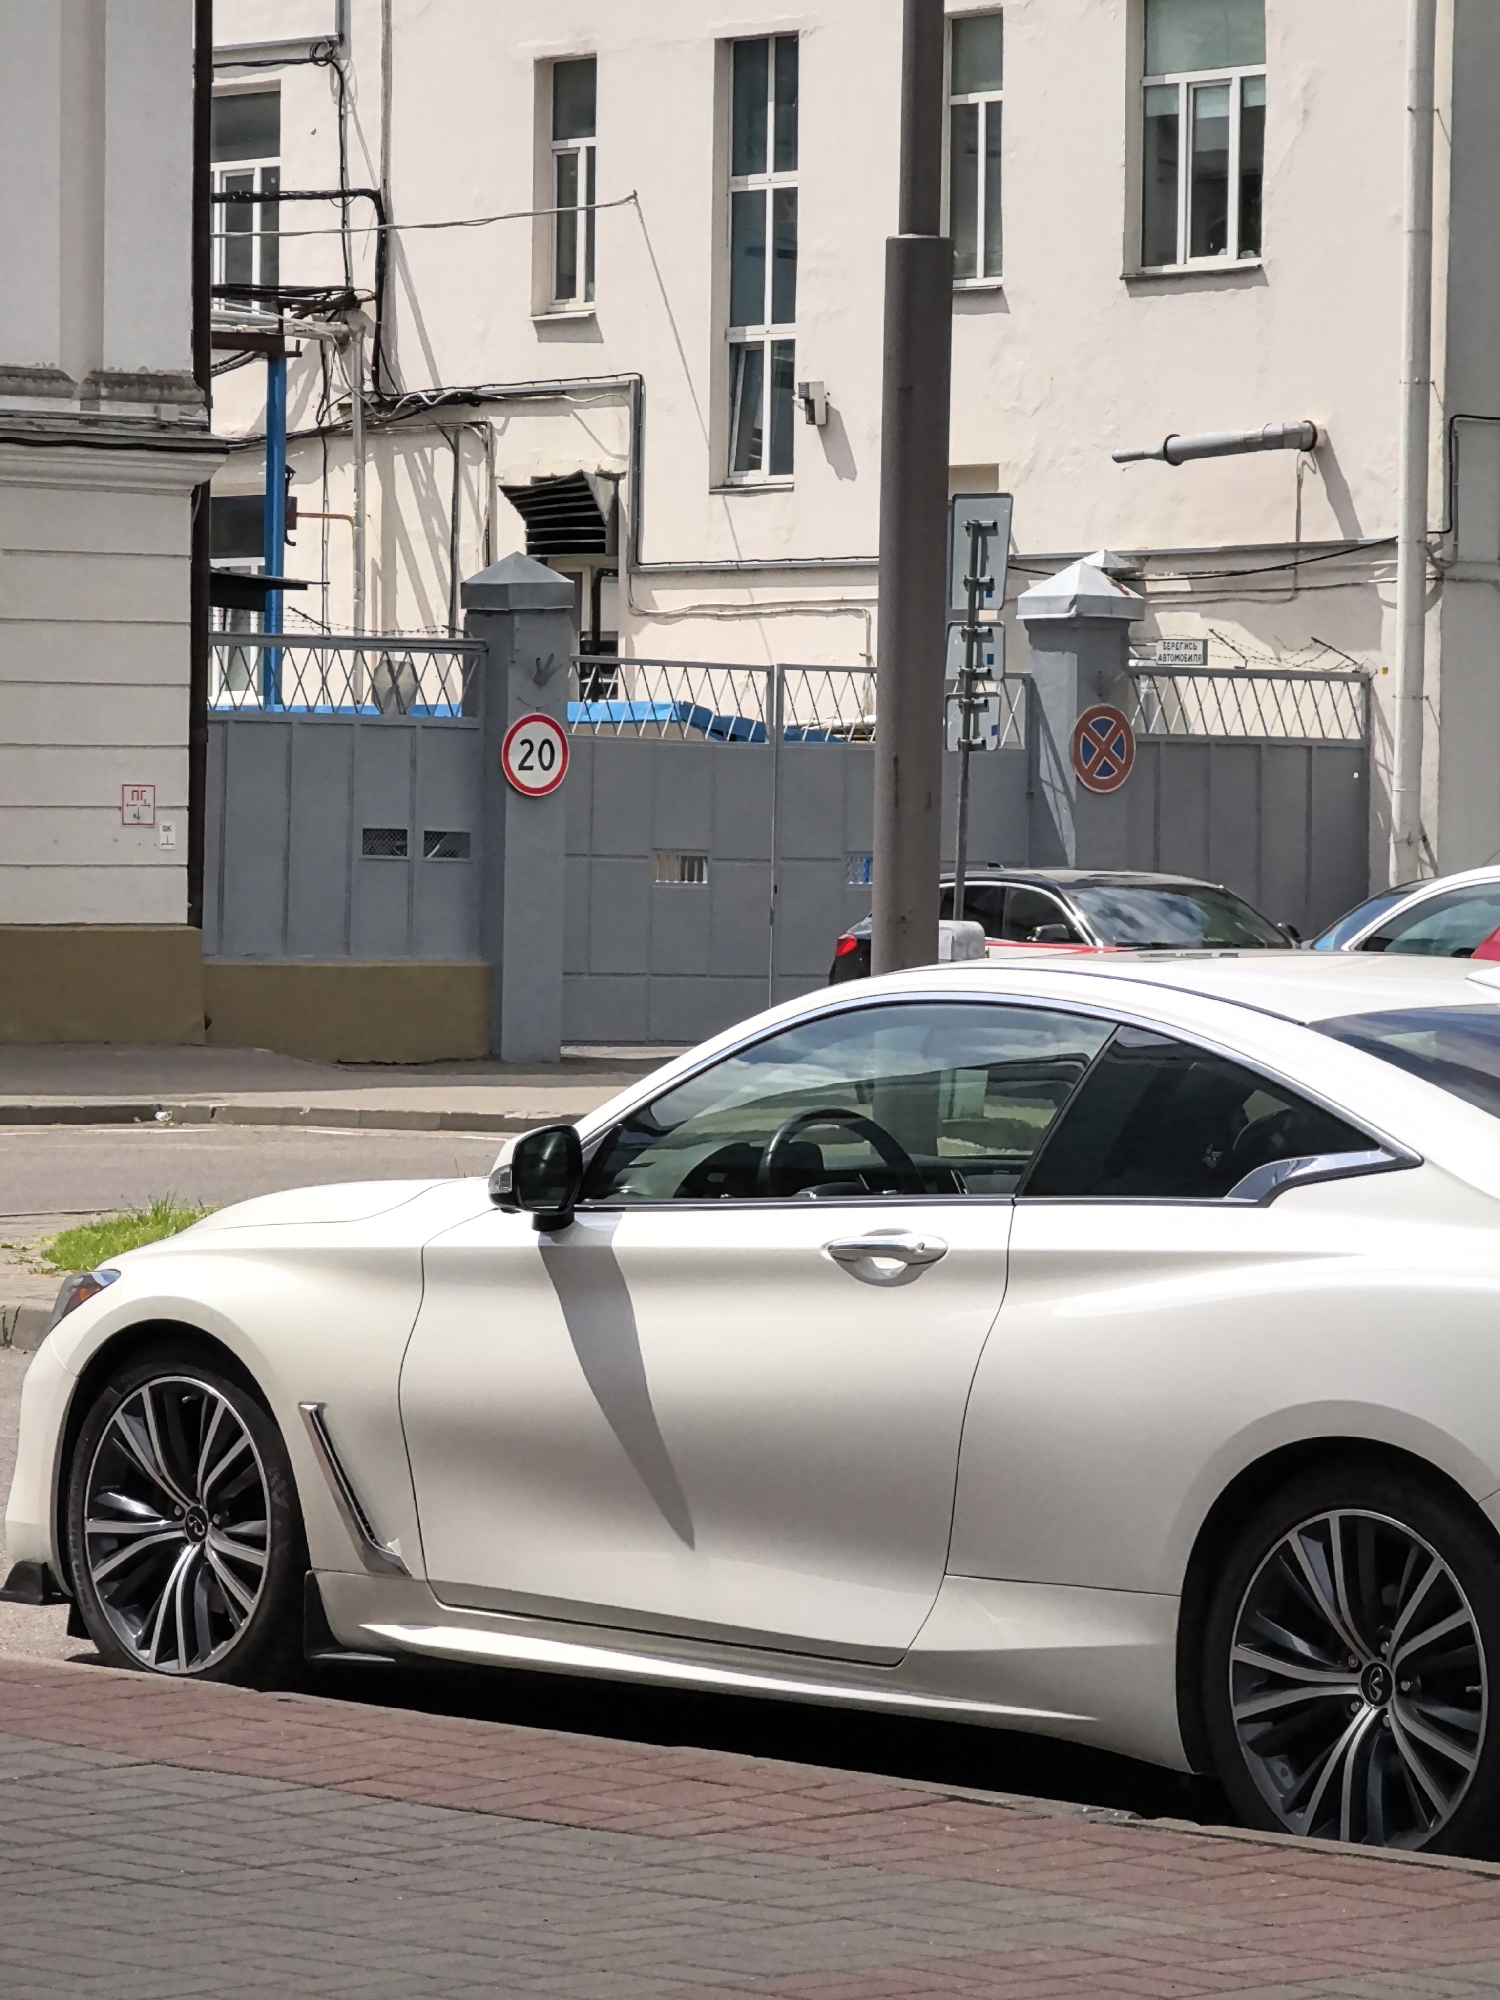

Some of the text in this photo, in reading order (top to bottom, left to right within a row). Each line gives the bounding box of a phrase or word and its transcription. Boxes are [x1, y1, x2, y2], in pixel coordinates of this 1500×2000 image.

[1163, 642, 1197, 650] БЕРЕГИСЬ
[1158, 654, 1202, 662] АВТОМОБИЛЯ
[518, 738, 555, 771] 20
[131, 790, 146, 801] ПГ
